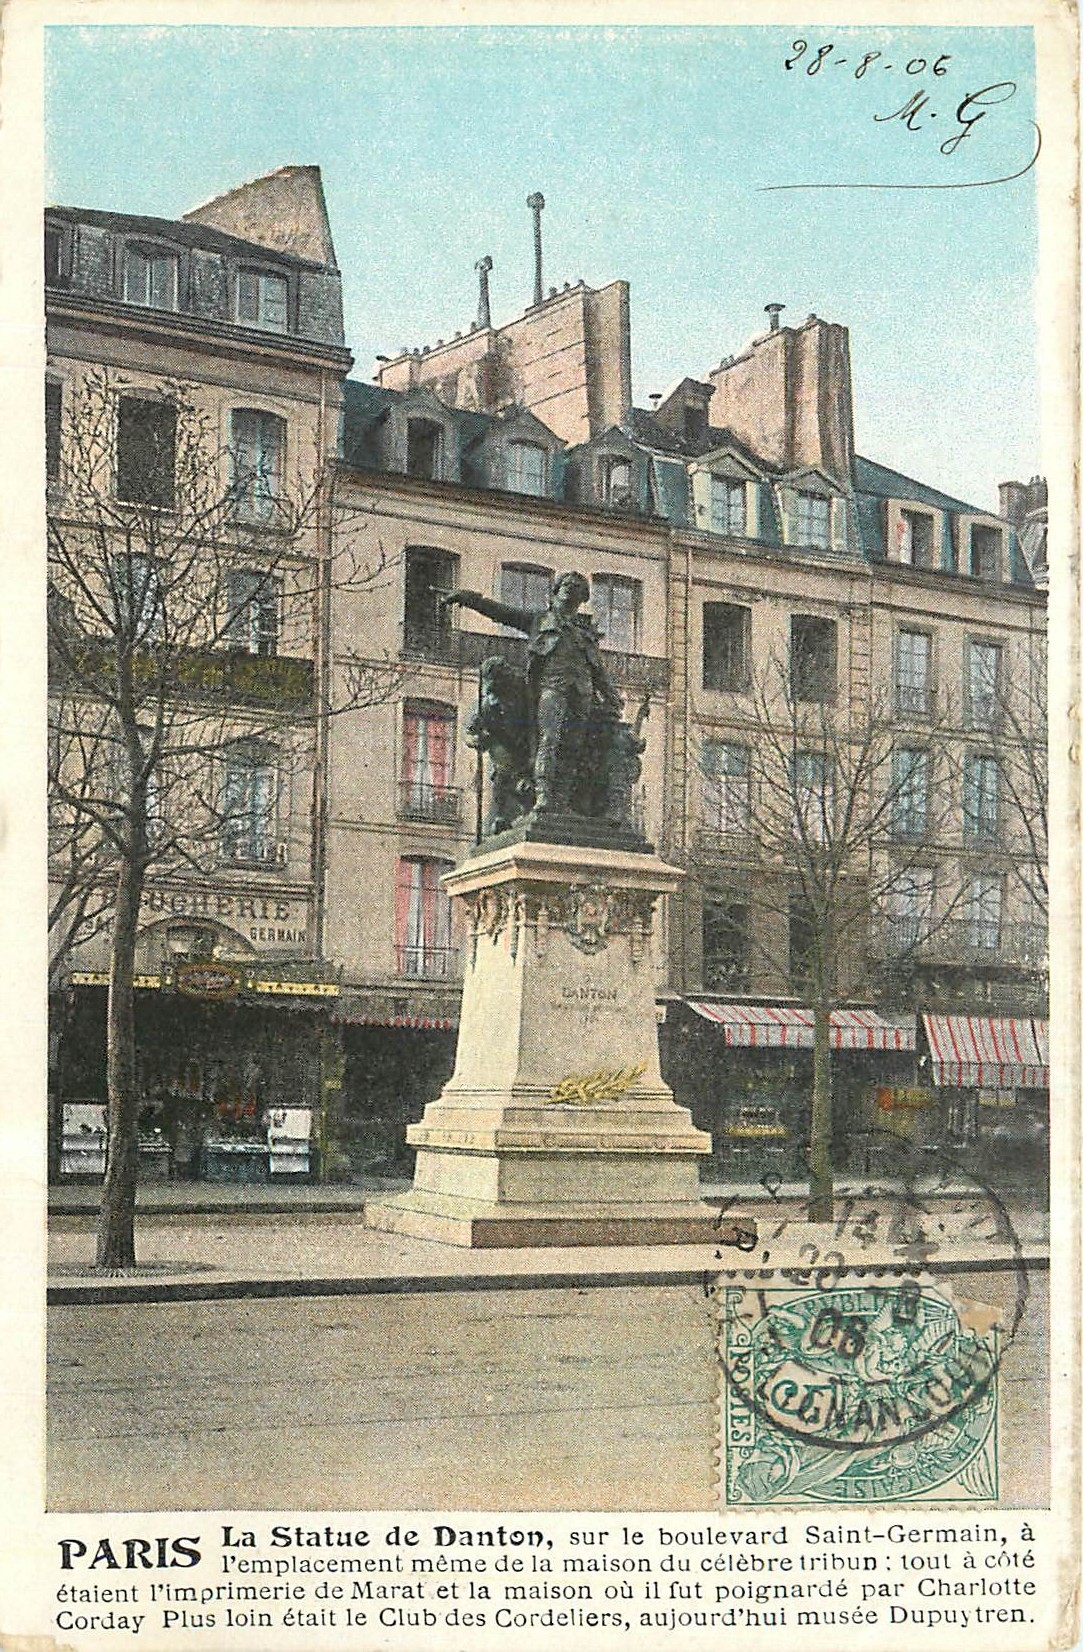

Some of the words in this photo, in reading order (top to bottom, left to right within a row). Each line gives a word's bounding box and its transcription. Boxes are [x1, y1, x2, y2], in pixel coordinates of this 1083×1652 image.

[249, 926, 307, 943] GERMAIN
[562, 987, 618, 1000] DANTON
[221, 1525, 257, 1548] La
[270, 1526, 371, 1548] Statue
[385, 1525, 420, 1547] de
[433, 1525, 554, 1551] Danton,
[569, 1531, 610, 1546] sur
[622, 1527, 644, 1546] le
[658, 1526, 788, 1546] boulevard
[805, 1524, 1007, 1547] Saint-Germain,
[1020, 1522, 1036, 1542] à
[57, 1536, 202, 1570] PARIS
[222, 1555, 404, 1578] l'emplacement
[411, 1554, 487, 1573] même
[494, 1554, 524, 1573] de
[532, 1554, 554, 1573] la
[563, 1554, 652, 1573] maison
[659, 1554, 691, 1573] du
[700, 1552, 793, 1572] célèbre
[900, 1553, 951, 1571] tout
[963, 1550, 977, 1569] à
[984, 1549, 1035, 1569] côté
[56, 1583, 139, 1603] étaient
[150, 1581, 306, 1605] l'imprimerie
[314, 1580, 344, 1600] de
[350, 1580, 425, 1600] Marat
[436, 1582, 459, 1600] et
[469, 1581, 492, 1600] la
[504, 1581, 593, 1600] maison
[604, 1580, 634, 1600] où
[645, 1581, 661, 1600] il
[669, 1580, 703, 1600] fut
[715, 1578, 848, 1604] poignardé
[861, 1583, 905, 1601] par
[917, 1577, 1036, 1597] Charlotte
[55, 1610, 146, 1634] Corday
[162, 1609, 216, 1629] Plus
[226, 1608, 273, 1627] loin
[282, 1607, 337, 1627] était
[346, 1608, 367, 1626] le
[379, 1607, 437, 1627] Club
[445, 1608, 486, 1627] des
[495, 1608, 631, 1632] Cordeliers,
[639, 1607, 787, 1631] aujourd'hui
[797, 1605, 878, 1626] musée
[890, 1605, 1034, 1628] Dupuytren.
